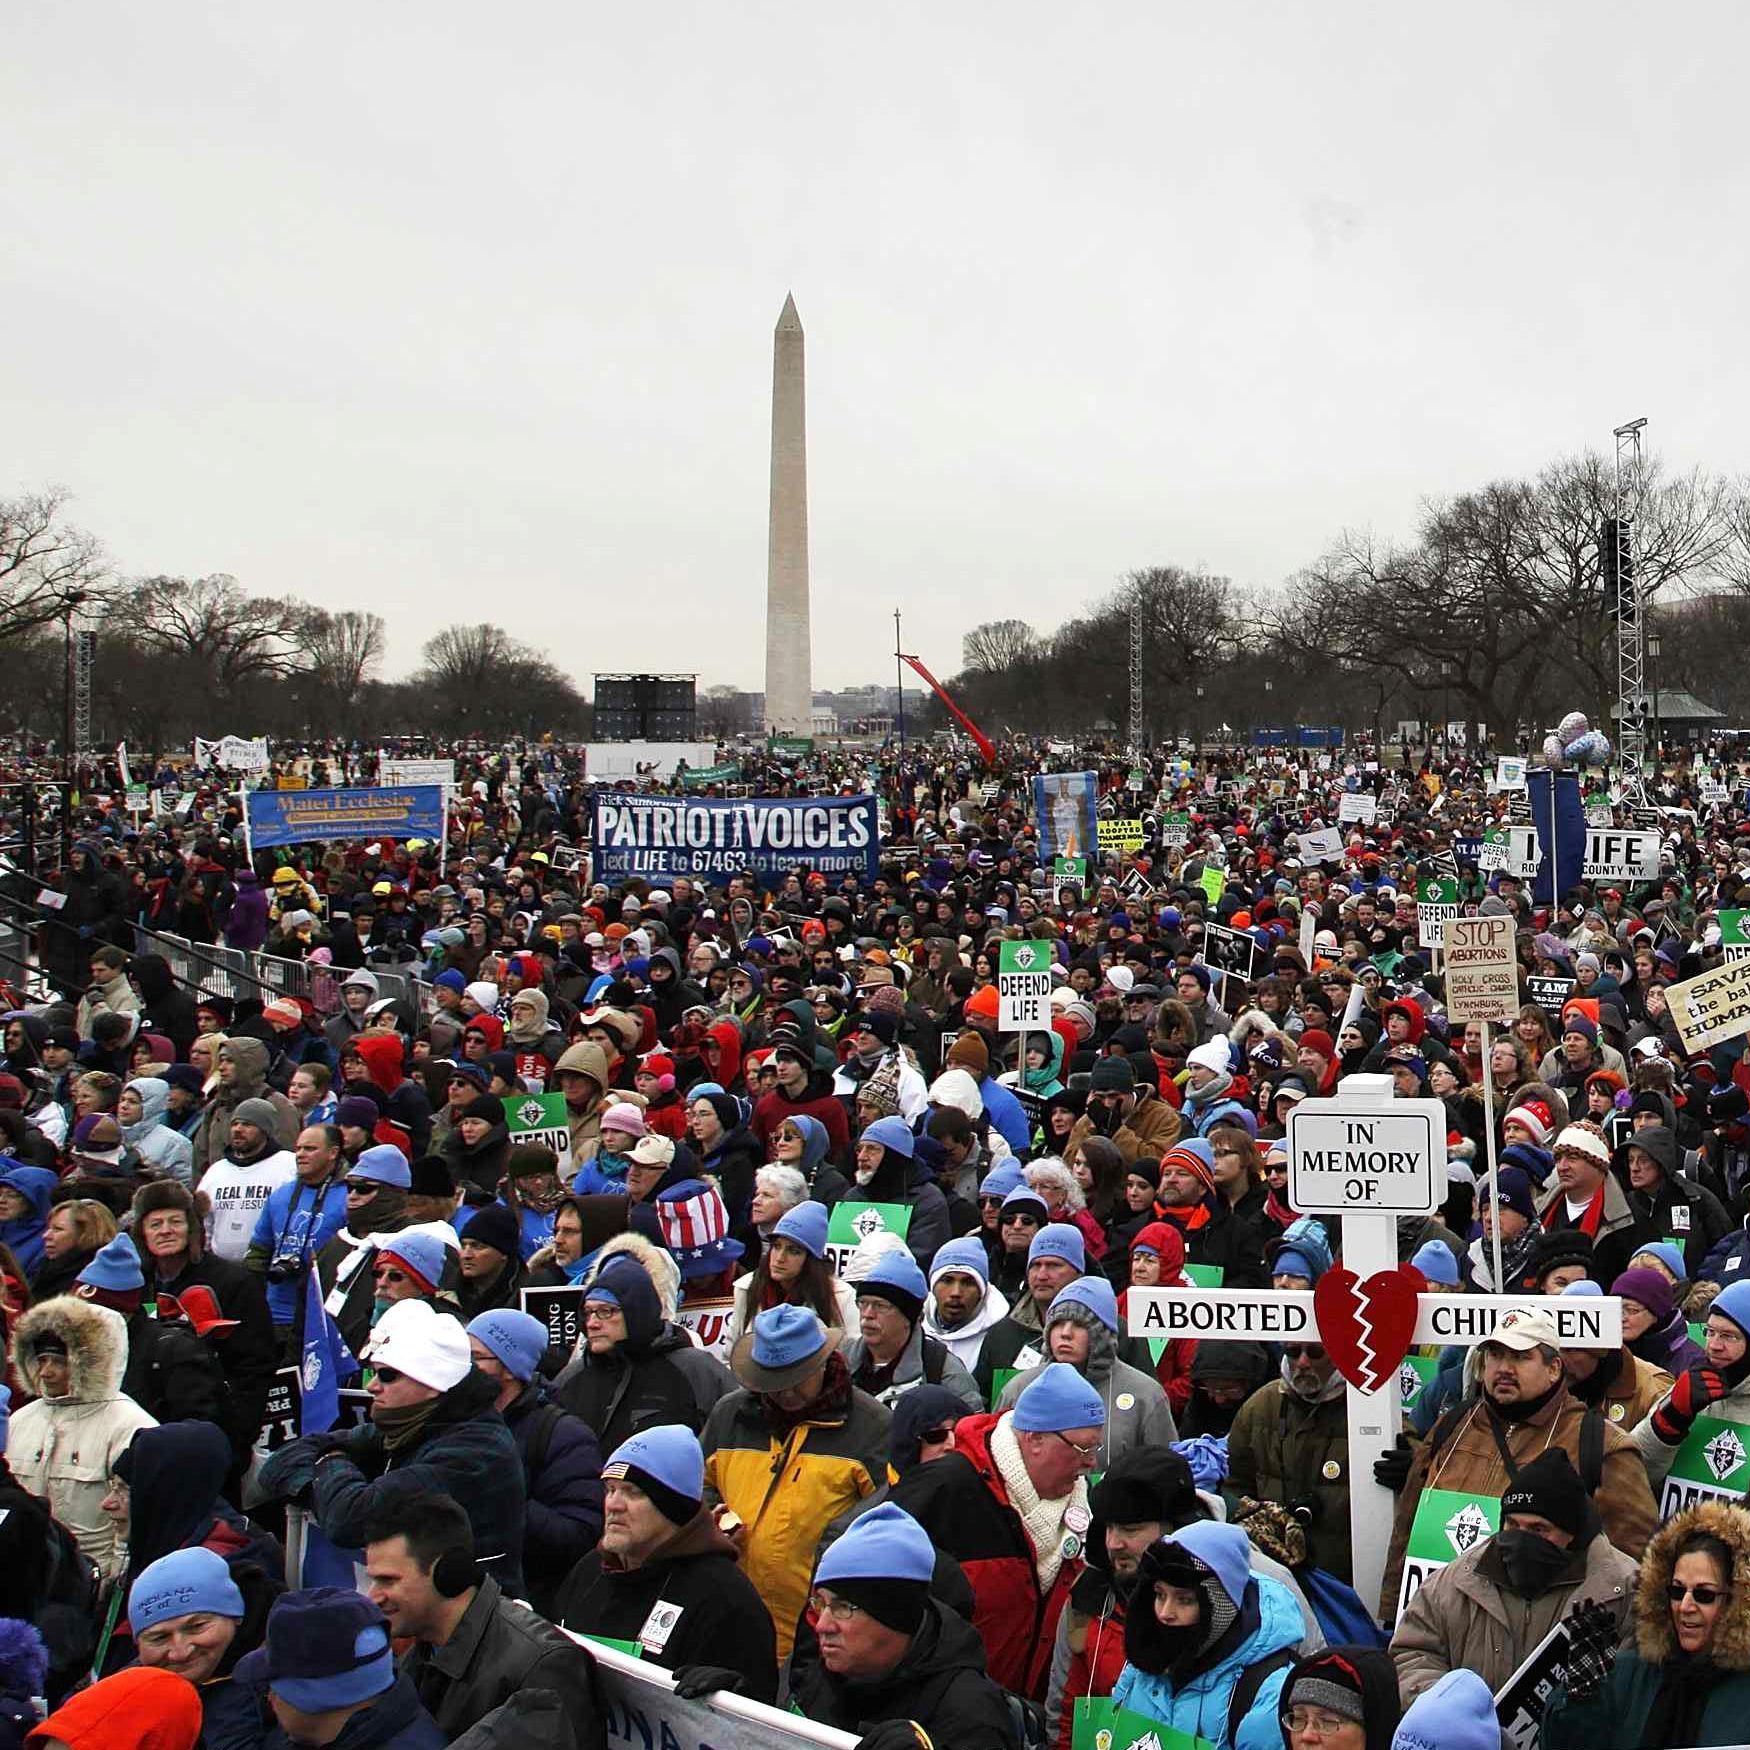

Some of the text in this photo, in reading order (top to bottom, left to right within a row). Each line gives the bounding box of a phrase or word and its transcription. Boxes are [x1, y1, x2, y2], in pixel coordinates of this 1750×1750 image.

[597, 807, 870, 849] PATRIOT VOICES
[1483, 844, 1509, 857] DEFEND
[1585, 836, 1643, 865] IFE
[602, 851, 867, 872] Text LIFE to 67463 to learn more!
[1487, 857, 1502, 868] LIFE
[1583, 864, 1622, 875] COUNTY
[1629, 866, 1647, 876] N.Y.
[1419, 905, 1456, 921] DEFEND
[1427, 925, 1444, 941] LIF
[1455, 922, 1506, 947] STOP
[1450, 949, 1507, 963] ABORTIONS
[1001, 974, 1050, 997] DEFEND
[1451, 973, 1511, 984] HOLY CROSS
[1452, 984, 1485, 994] CATHOLIC
[1533, 981, 1568, 993] I AM
[1012, 999, 1039, 1021] LIFE
[1454, 1000, 1504, 1010] LYNCHBURG
[1688, 999, 1718, 1019] the
[513, 1130, 569, 1153] EFEND
[1346, 1123, 1375, 1145] IN
[1302, 1150, 1421, 1174] MEMORY
[215, 1186, 272, 1201] REAL MEN
[216, 1201, 266, 1212] LOVE JESU
[1143, 1301, 1601, 1339] ABORTED CHIEN
